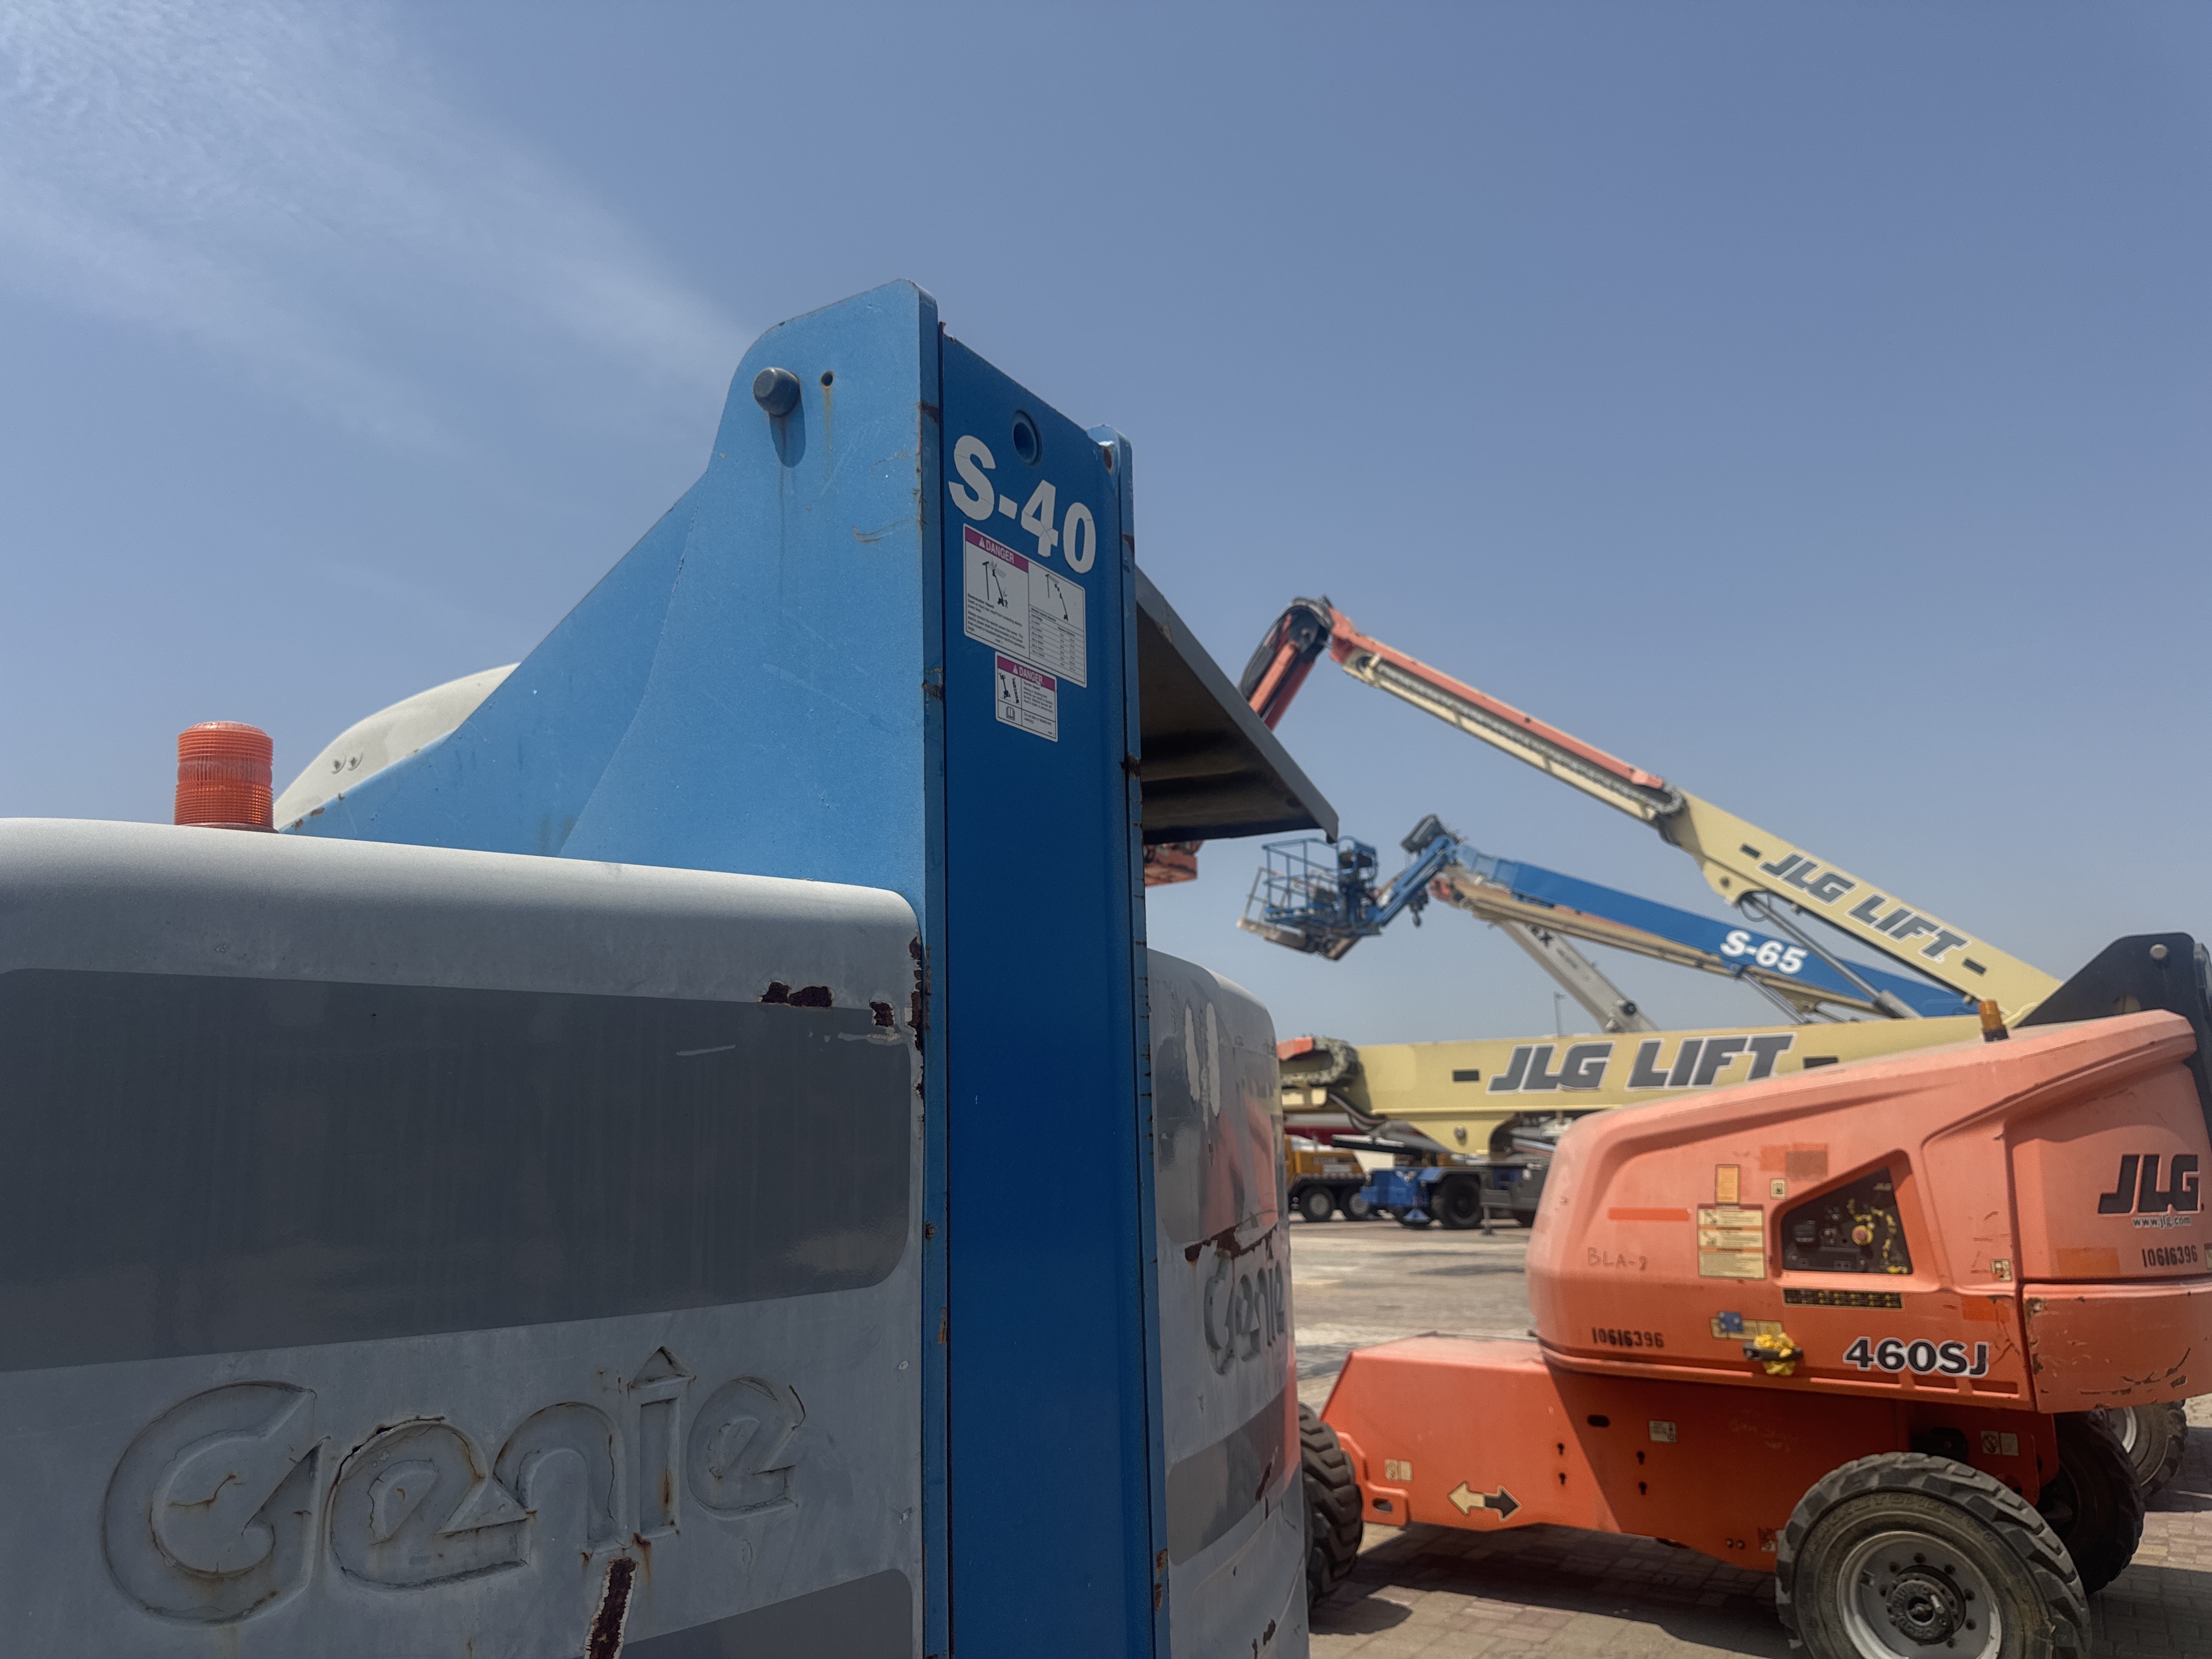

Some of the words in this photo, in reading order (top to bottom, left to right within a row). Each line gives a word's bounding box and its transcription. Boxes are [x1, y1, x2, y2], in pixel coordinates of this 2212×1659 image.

[948, 435, 1096, 573] S-40
[985, 539, 1014, 565] DANGER
[1019, 666, 1043, 685] DANGER
[1757, 851, 1860, 906] JLG
[1845, 893, 1973, 963] LIFT
[1720, 929, 1808, 974] S-65
[1485, 1041, 1615, 1094] JLG
[1624, 1032, 1797, 1092] LIFT
[2097, 1154, 2201, 1215] JLG
[2132, 1215, 2191, 1229] www.jlg.com
[2141, 1244, 2198, 1268] 10616396
[1592, 1327, 1664, 1348] 10616396
[1844, 1337, 1990, 1378] 460SJ
[101, 1347, 806, 1624] Genie
